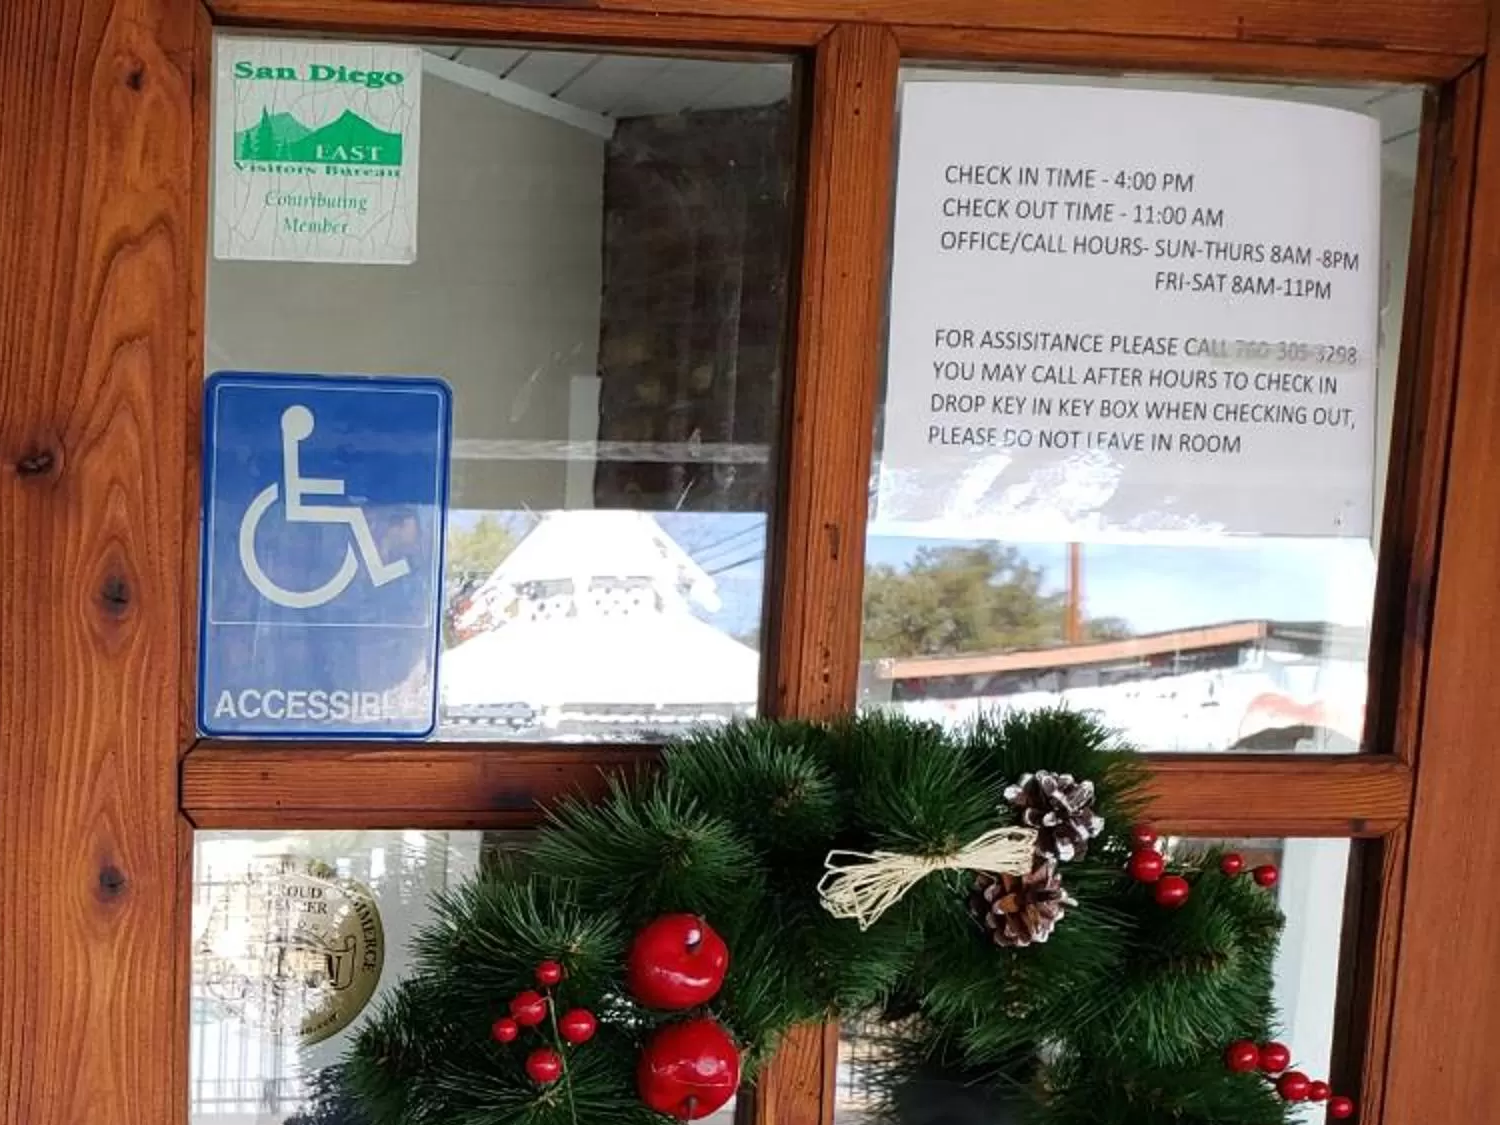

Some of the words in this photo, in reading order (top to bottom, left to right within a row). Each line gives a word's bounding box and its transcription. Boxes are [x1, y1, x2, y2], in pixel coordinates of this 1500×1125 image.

[235, 61, 297, 81] San
[310, 64, 404, 88] Diego
[315, 144, 383, 161] EAST
[945, 166, 1012, 184] CHECK
[1019, 167, 1038, 185] IN
[1046, 168, 1096, 188] TIME
[1114, 170, 1156, 191] 4:00
[1163, 173, 1194, 192] PM
[265, 191, 368, 214] Contributing
[943, 198, 1009, 218] CHECK
[1015, 200, 1058, 219] OUT
[1064, 202, 1114, 222] TIME
[1134, 205, 1186, 225] 11:00
[1192, 208, 1223, 227] AM
[283, 217, 349, 234] Member
[941, 231, 1066, 254] OFFICE/CALL
[1073, 236, 1148, 256] HOURS-
[1155, 240, 1265, 262] SUN-THURS
[1271, 245, 1311, 265] 8AM
[1317, 250, 1358, 271] -8PM
[1156, 272, 1227, 292] FRI-SAT
[1231, 276, 1332, 300] 8AM-11PM
[936, 329, 974, 348] FOR
[980, 331, 1102, 352] ASSISITANCE
[1110, 336, 1178, 356] PLEASE
[1183, 338, 1228, 359] CALL
[933, 362, 974, 380] YOU
[982, 363, 1026, 382] MAY
[1032, 365, 1077, 384] CALL
[1083, 367, 1142, 386] AFTER
[1150, 369, 1217, 389] HOURS
[1224, 372, 1248, 390] TO
[1254, 373, 1314, 392] CHECK
[1320, 377, 1336, 394] IN
[931, 394, 985, 413] DROP
[992, 396, 1026, 414] KEY
[1032, 398, 1051, 415] IN
[1059, 399, 1094, 416] KEY
[1100, 400, 1138, 418] BOX
[1146, 402, 1206, 420] WHEN
[1213, 404, 1306, 424] CHECKING
[929, 426, 996, 446] PLEASE
[1002, 429, 1032, 447] DO
[1040, 430, 1081, 448] NOT
[1152, 434, 1172, 451] IN
[1180, 434, 1240, 453] ROOM
